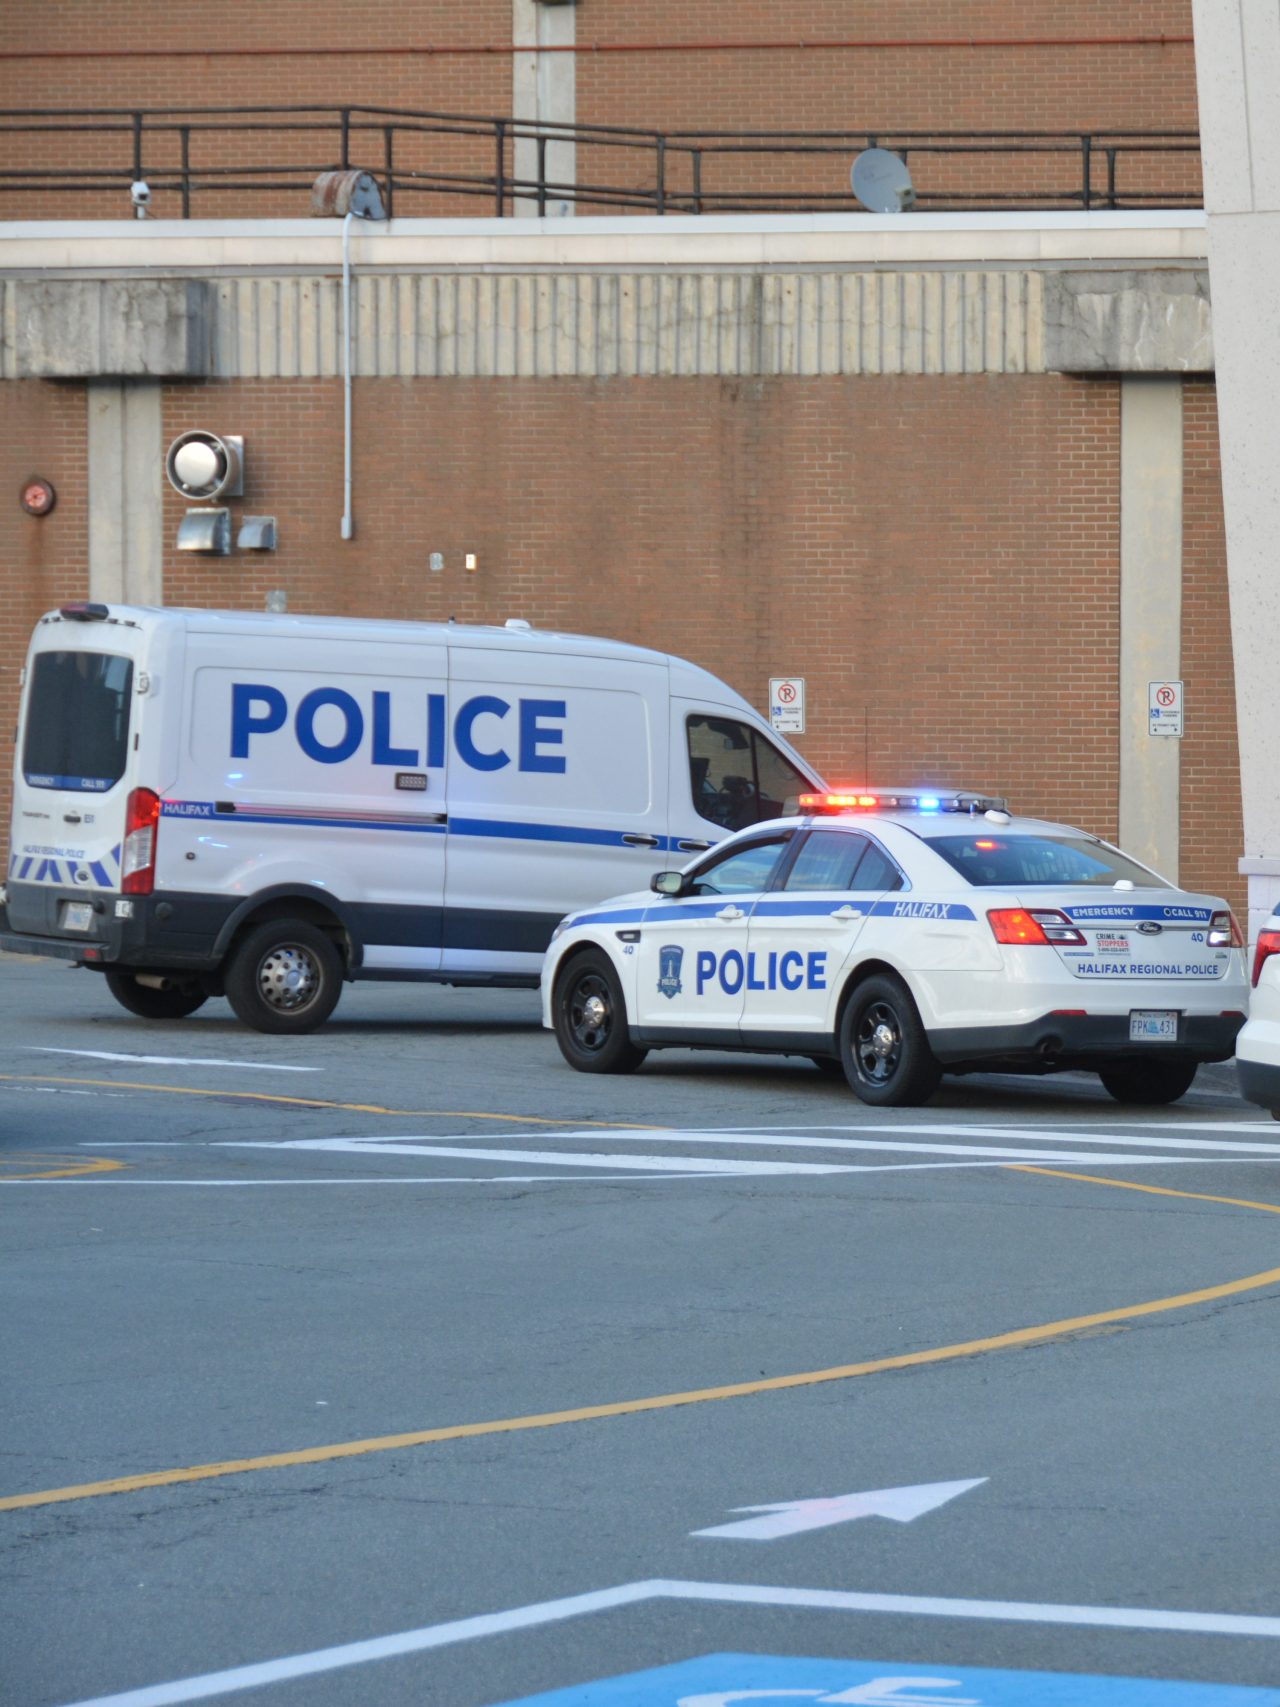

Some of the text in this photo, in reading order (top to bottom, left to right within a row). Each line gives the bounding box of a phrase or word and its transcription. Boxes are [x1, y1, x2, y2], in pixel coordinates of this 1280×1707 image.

[230, 683, 566, 774] POLICE
[164, 804, 210, 816] HALIFAX
[893, 902, 951, 920] HALIFAX
[1072, 907, 1134, 917] EMERGENCY
[1171, 908, 1207, 919] CALL 911
[1191, 933, 1204, 943] 40
[622, 946, 634, 955] 40
[696, 949, 828, 996] POLICE
[1078, 964, 1218, 975] HALIFAX REGIONAL POLICE
[1159, 1020, 1175, 1034] 431
